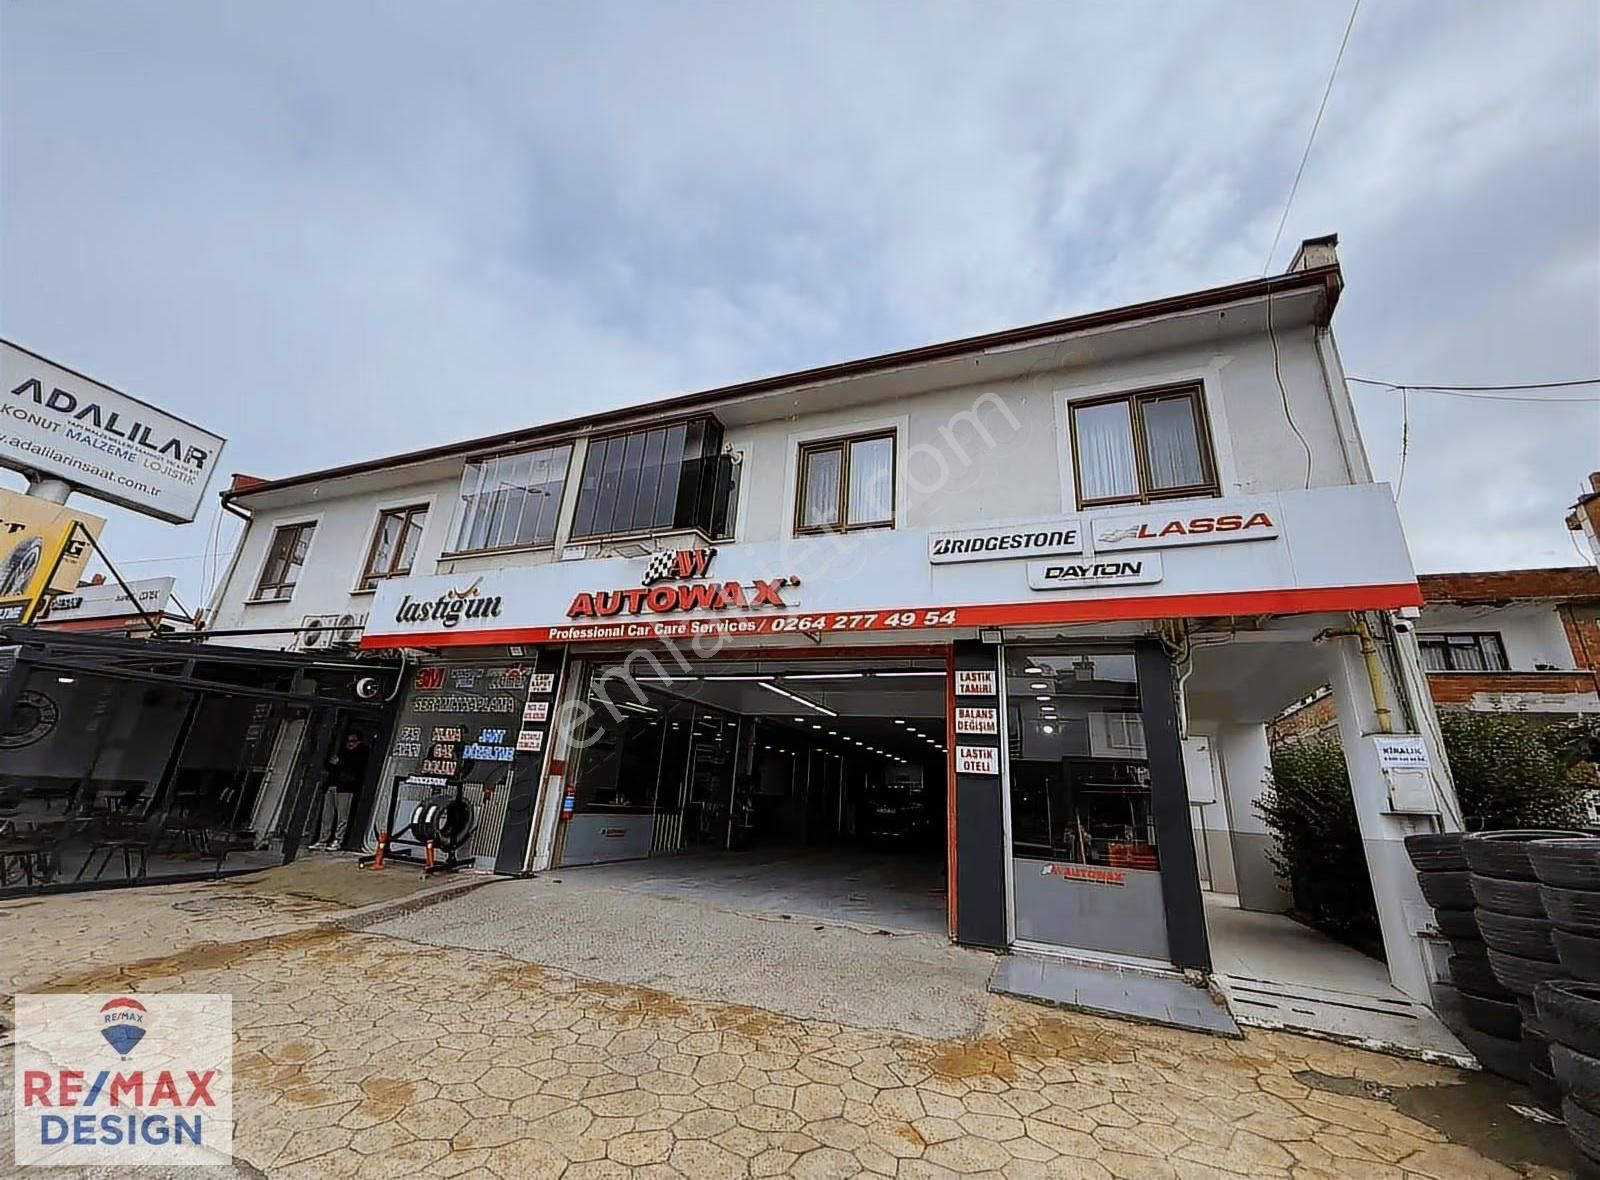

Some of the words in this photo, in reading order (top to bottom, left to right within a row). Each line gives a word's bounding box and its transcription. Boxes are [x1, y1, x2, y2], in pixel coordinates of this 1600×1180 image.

[1, 403, 61, 433] KONUT
[65, 429, 137, 463] MALZEME
[1136, 512, 1274, 539] LASSA
[933, 529, 1077, 556] BRIDGESTONE
[1044, 561, 1143, 579] DAYTON
[566, 577, 789, 618] AUTOWAX
[549, 625, 625, 640] Professional
[627, 623, 651, 637] Car
[654, 623, 686, 635] Care
[771, 616, 826, 631] 0264
[832, 614, 878, 629] 277
[884, 612, 916, 626] 49
[924, 610, 957, 625] 54
[958, 709, 993, 719] BALANS
